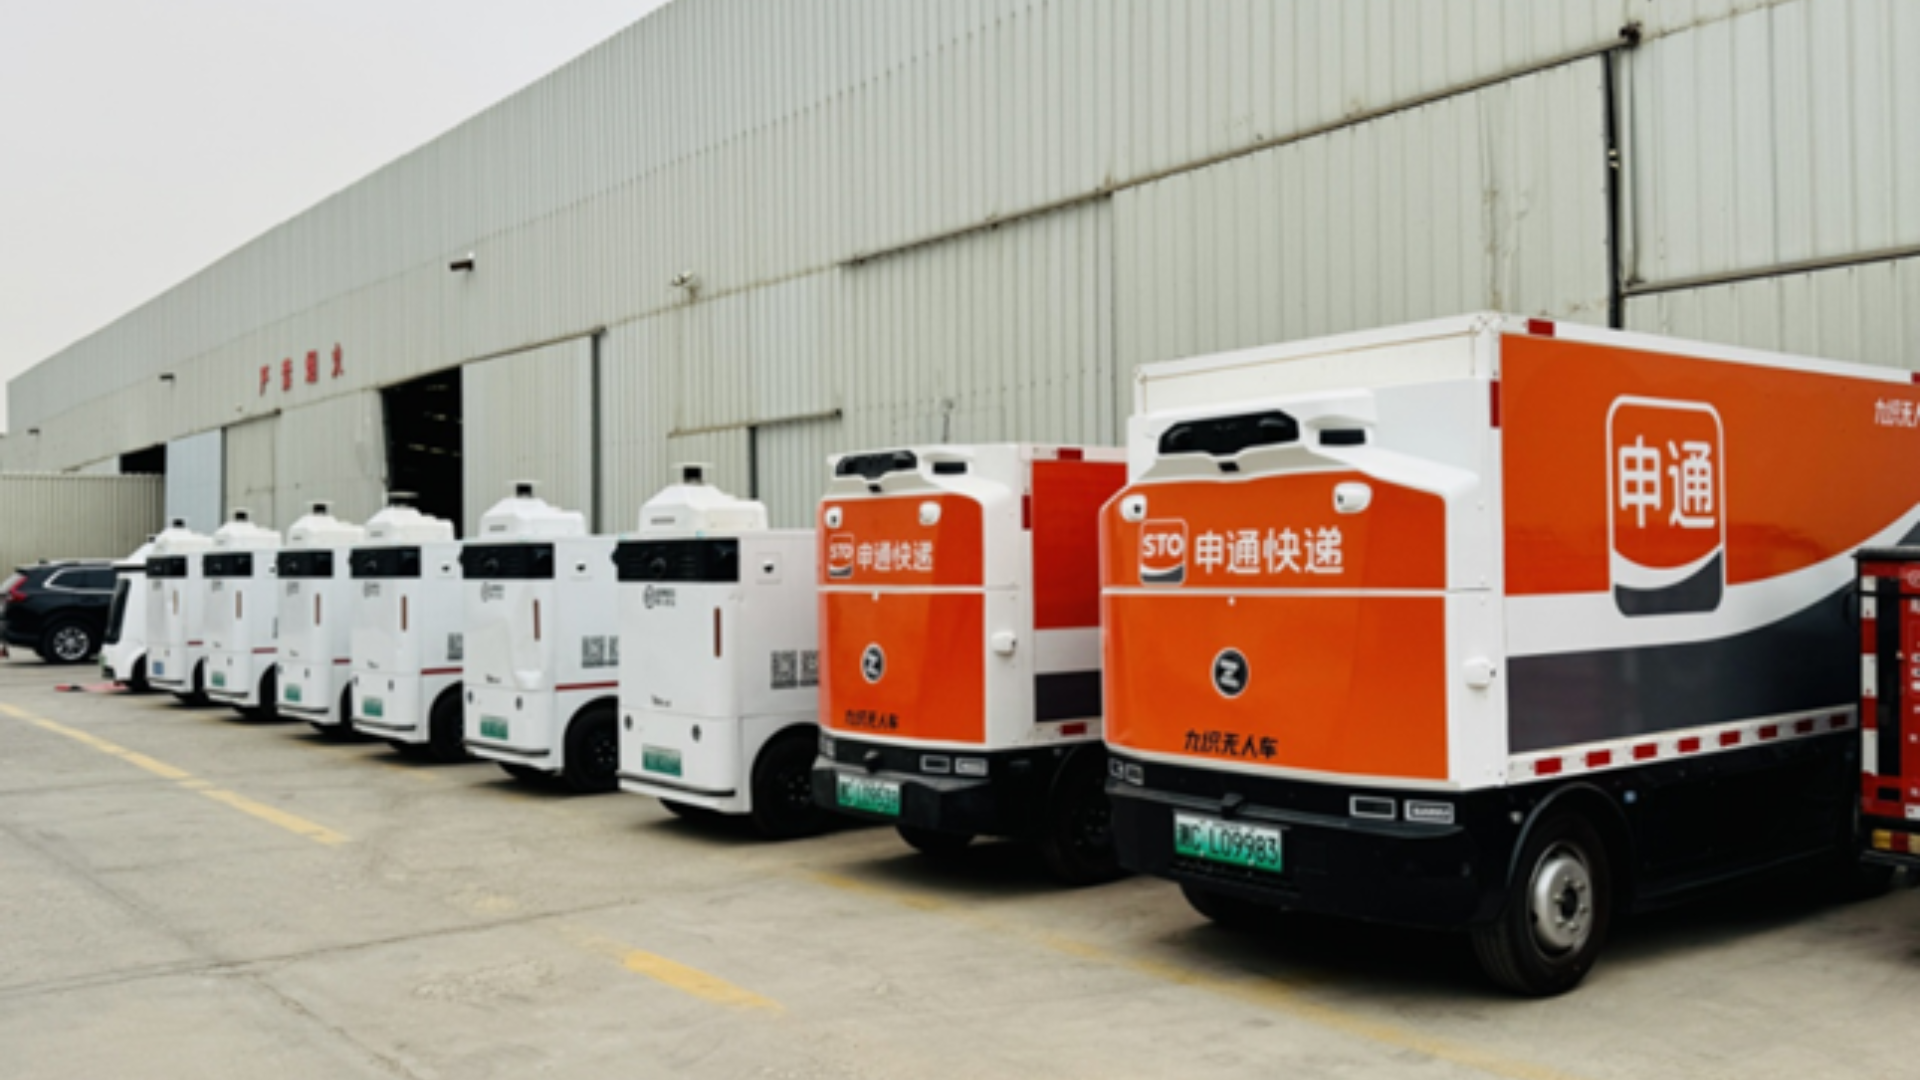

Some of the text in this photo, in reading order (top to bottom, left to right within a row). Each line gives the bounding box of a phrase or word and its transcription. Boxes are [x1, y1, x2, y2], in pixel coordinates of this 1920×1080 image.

[1618, 434, 1716, 528] 申通
[829, 542, 854, 559] STO
[857, 540, 933, 571] 申通快递
[1142, 533, 1185, 557] STO
[1194, 527, 1344, 574] 申通快递
